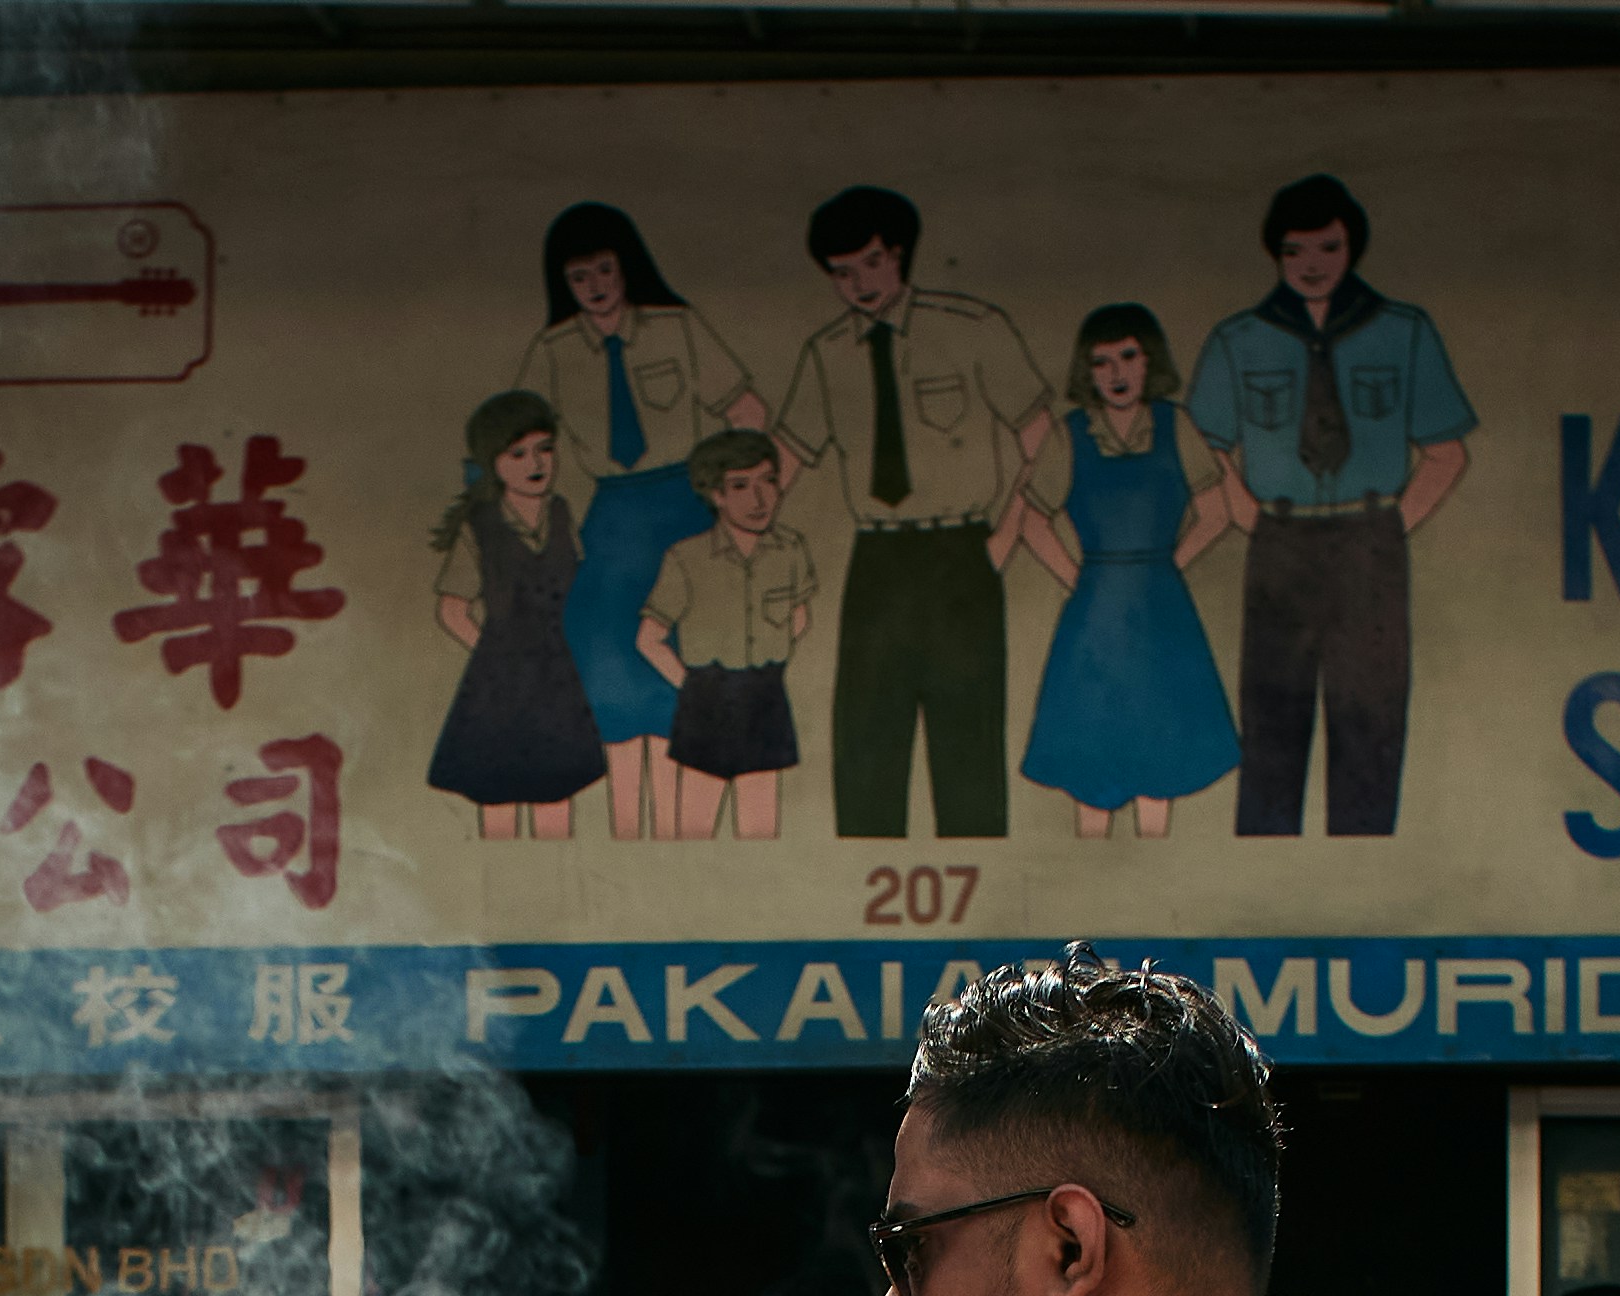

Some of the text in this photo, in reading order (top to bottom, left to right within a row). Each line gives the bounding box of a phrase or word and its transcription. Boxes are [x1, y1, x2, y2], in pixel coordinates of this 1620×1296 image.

[864, 866, 979, 926] 207
[466, 959, 1121, 1043] PAKAI
[118, 1245, 240, 1294] BHD
